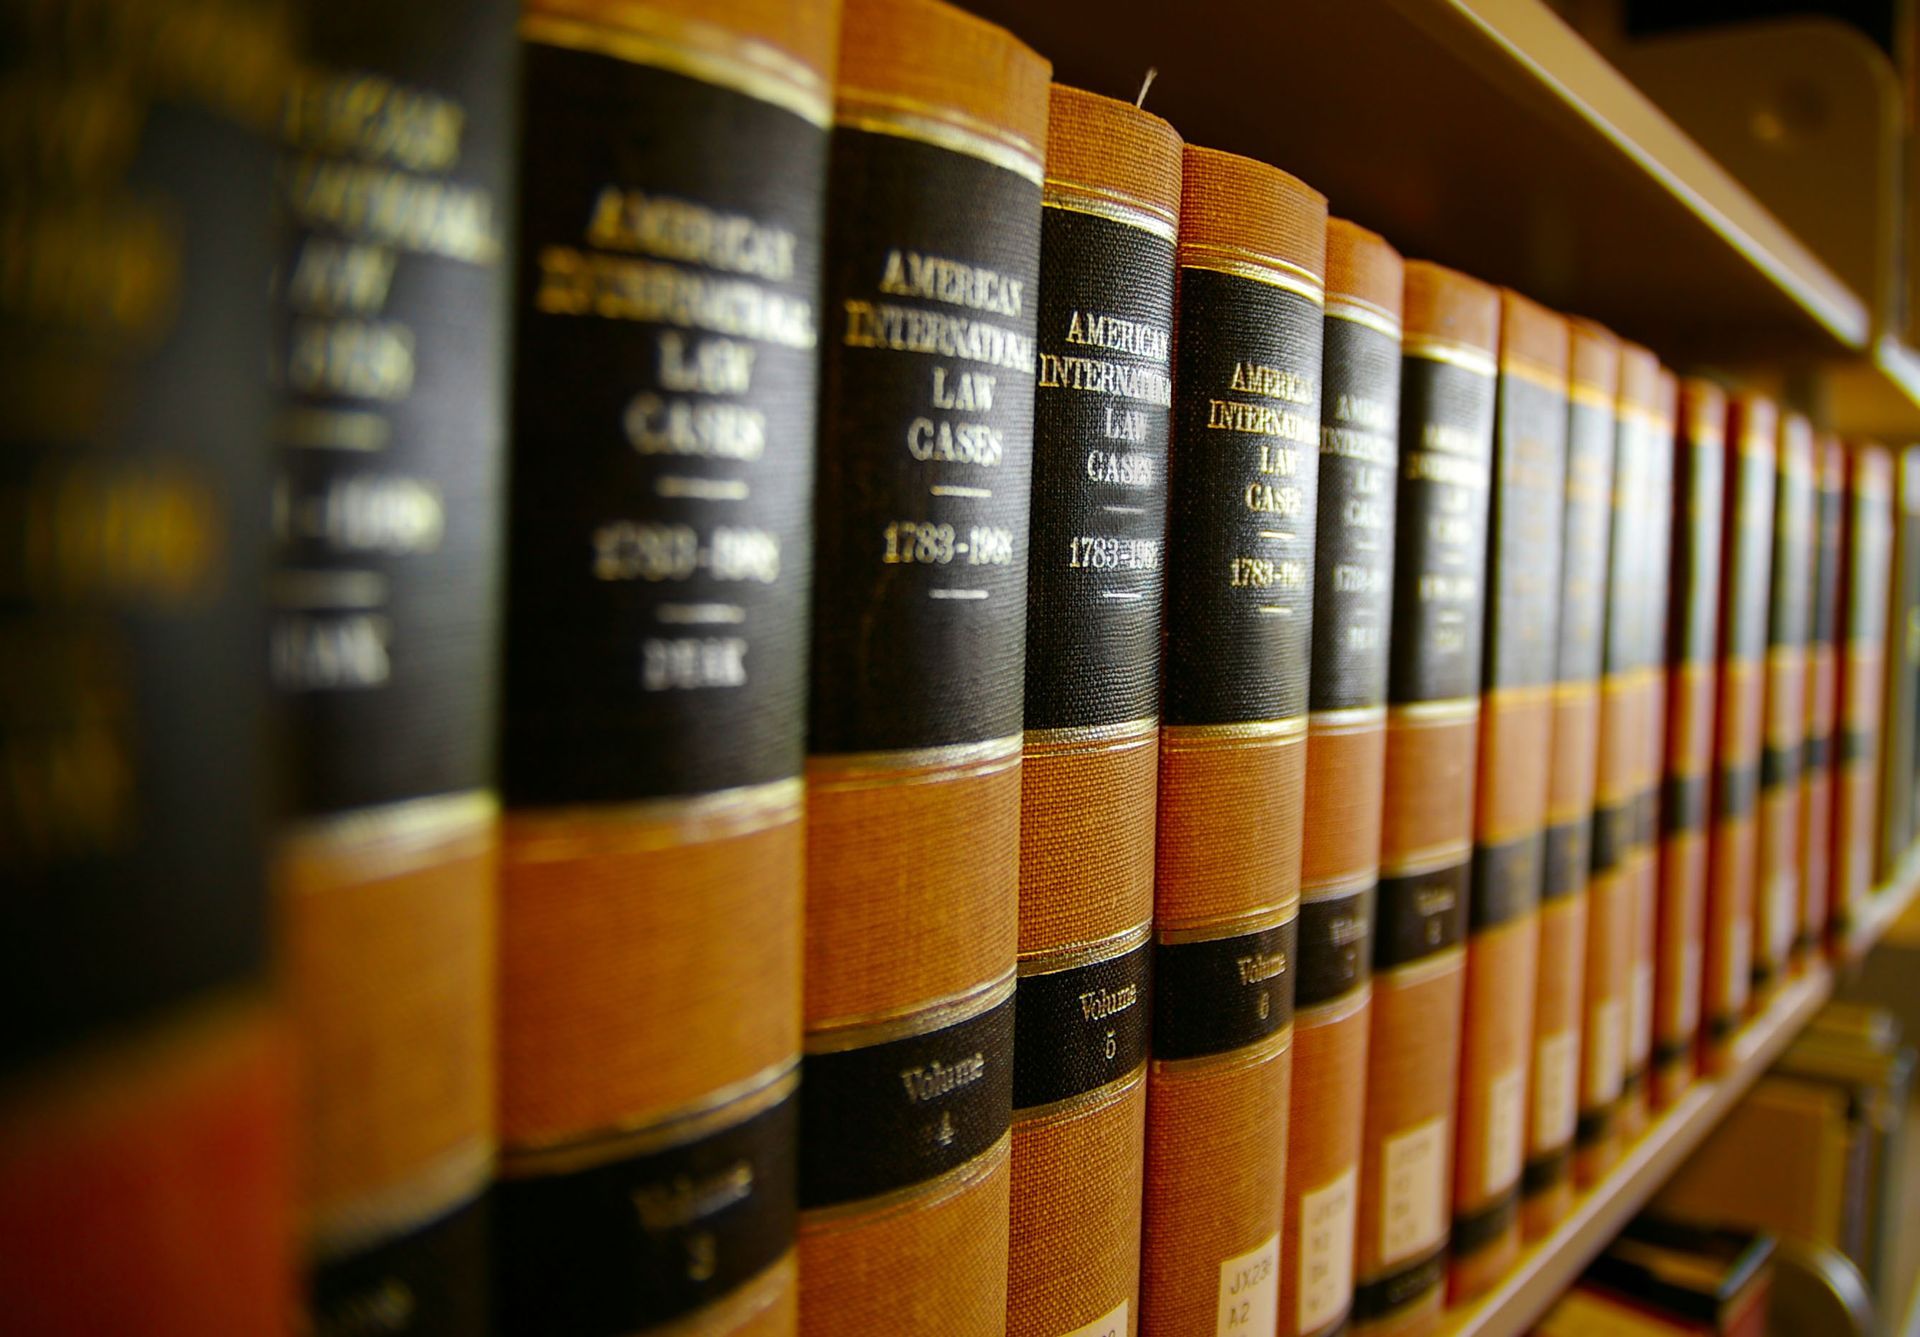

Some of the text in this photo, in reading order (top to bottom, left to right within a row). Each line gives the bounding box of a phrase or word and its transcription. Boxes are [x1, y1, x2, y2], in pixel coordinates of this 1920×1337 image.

[880, 250, 1023, 316] AMERICAN
[1066, 310, 1168, 361] AMERICAN
[658, 330, 757, 394] LAW
[932, 366, 997, 411] LAW
[623, 395, 767, 462] CASES
[907, 416, 1003, 467] CASES
[1103, 407, 1147, 441] LAW
[1087, 449, 1155, 487] CASES
[1259, 446, 1298, 477] LAW
[1079, 983, 1137, 1022] Volume
[1259, 992, 1270, 1020] 6
[1105, 1030, 1117, 1060] 5
[900, 1052, 985, 1101] Volume
[937, 1110, 955, 1147] 4
[1228, 1301, 1250, 1330] A2
